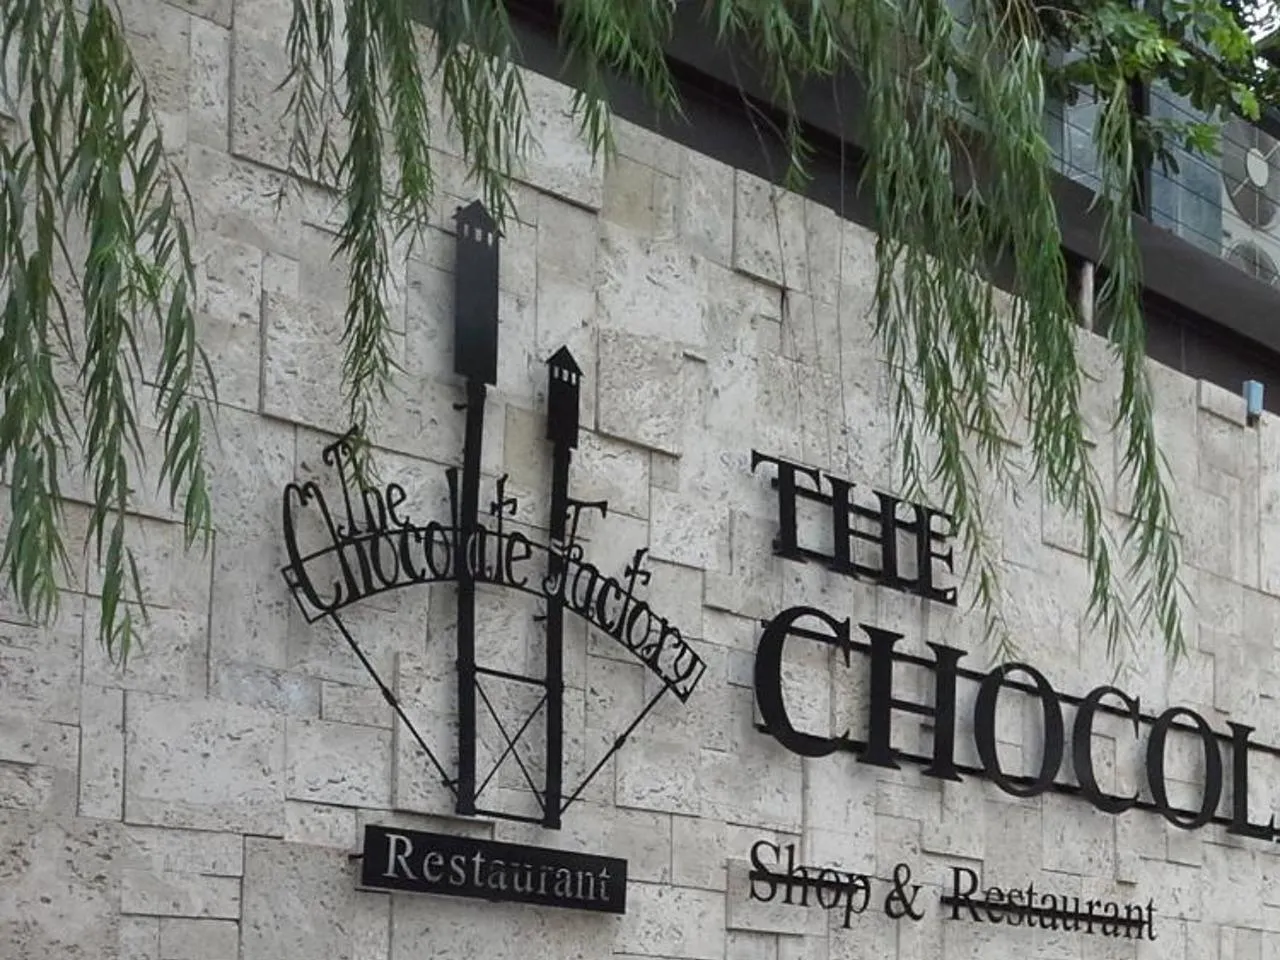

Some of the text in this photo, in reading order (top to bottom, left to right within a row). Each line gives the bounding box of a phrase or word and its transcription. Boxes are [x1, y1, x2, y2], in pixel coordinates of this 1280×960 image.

[323, 424, 410, 536] The
[751, 449, 958, 606] THE
[283, 467, 532, 611] Chocolate
[382, 833, 612, 902] Restaurant
[749, 839, 1158, 942] Shop & Restaurant
